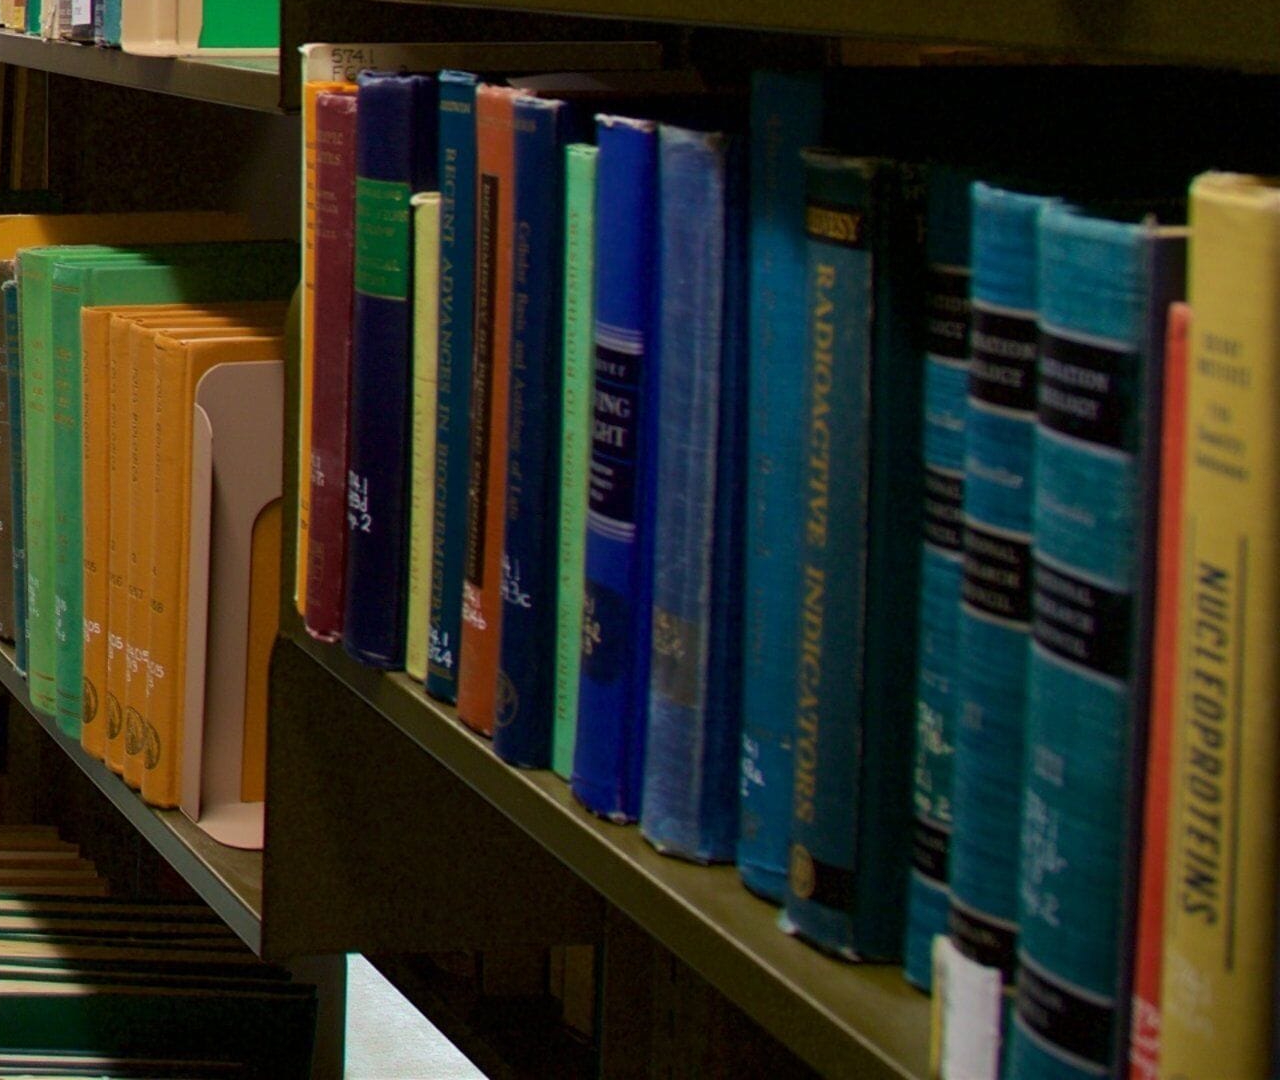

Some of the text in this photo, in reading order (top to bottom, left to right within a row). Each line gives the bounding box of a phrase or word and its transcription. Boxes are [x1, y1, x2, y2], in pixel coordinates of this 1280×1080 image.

[331, 49, 374, 64] 574.1
[443, 147, 457, 243] RECENT
[439, 257, 454, 397] ADVANCES
[437, 404, 450, 432] IN
[792, 263, 836, 825] RADIOACTIVE INDICATORS
[1182, 556, 1234, 927] NUCLEOPROTEINS
